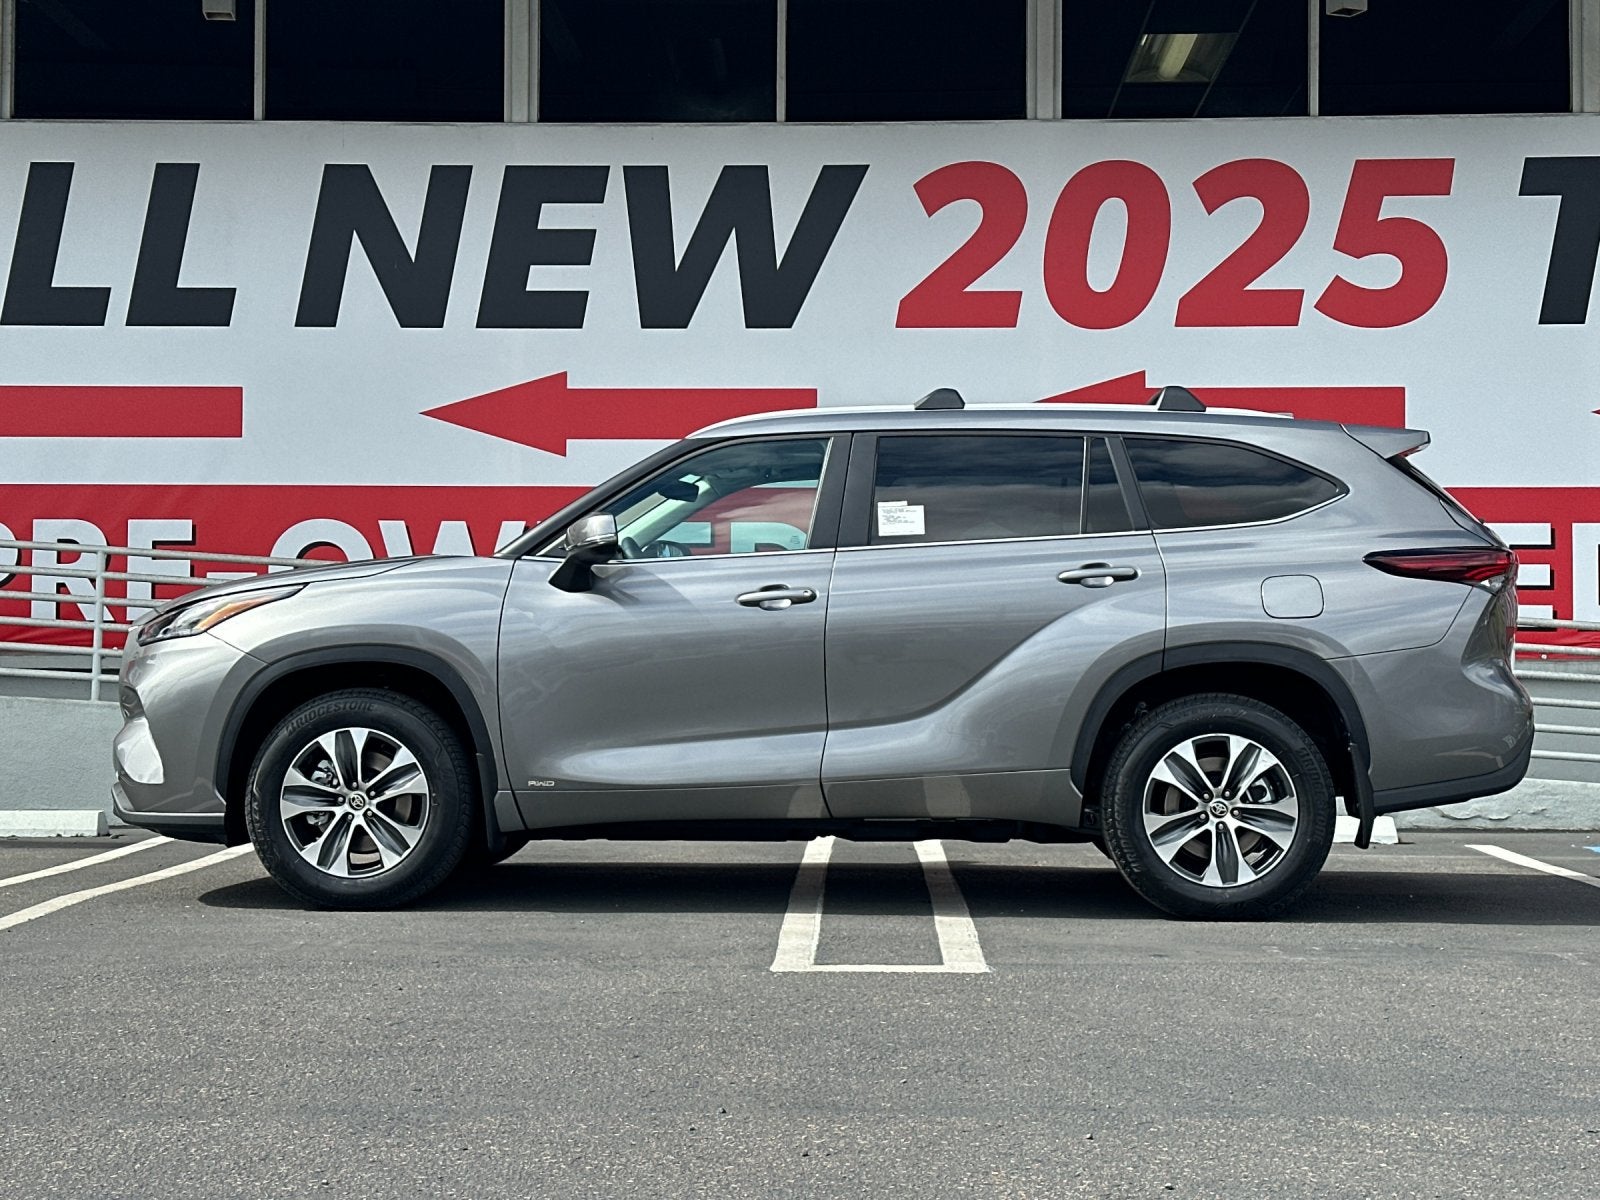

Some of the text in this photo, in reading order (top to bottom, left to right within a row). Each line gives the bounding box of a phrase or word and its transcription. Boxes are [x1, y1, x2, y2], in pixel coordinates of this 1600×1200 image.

[294, 163, 870, 329] NEW
[895, 157, 1455, 330] 2025
[284, 700, 377, 738] BRIDGESTONE
